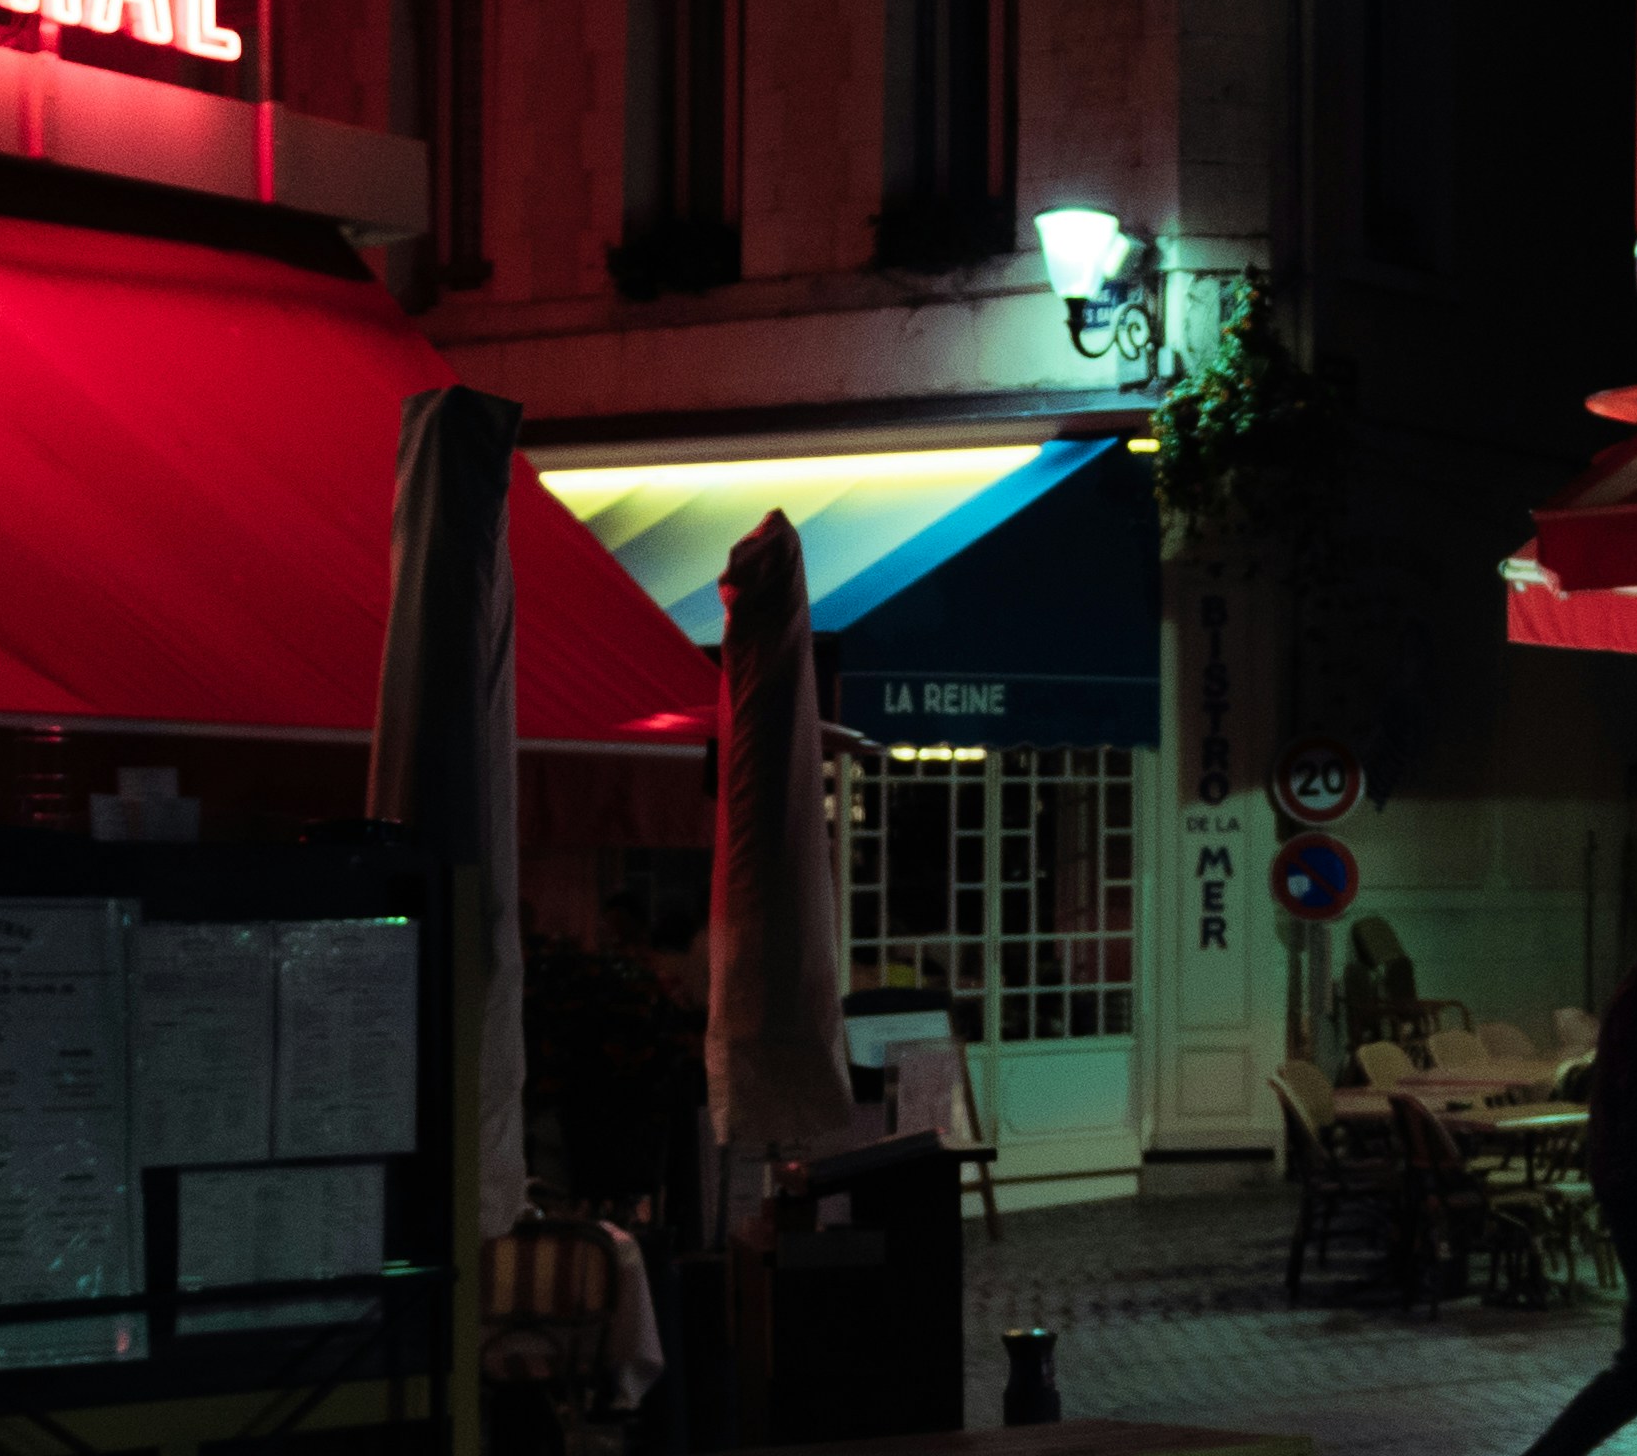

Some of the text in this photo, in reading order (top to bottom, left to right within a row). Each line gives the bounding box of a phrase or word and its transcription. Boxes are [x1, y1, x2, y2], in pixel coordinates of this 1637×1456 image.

[883, 682, 1006, 717] LA REINE
[1199, 595, 1230, 805] BISTRO
[1297, 758, 1347, 798] 20
[1187, 816, 1241, 834] DE LA
[1197, 846, 1234, 950] MER
